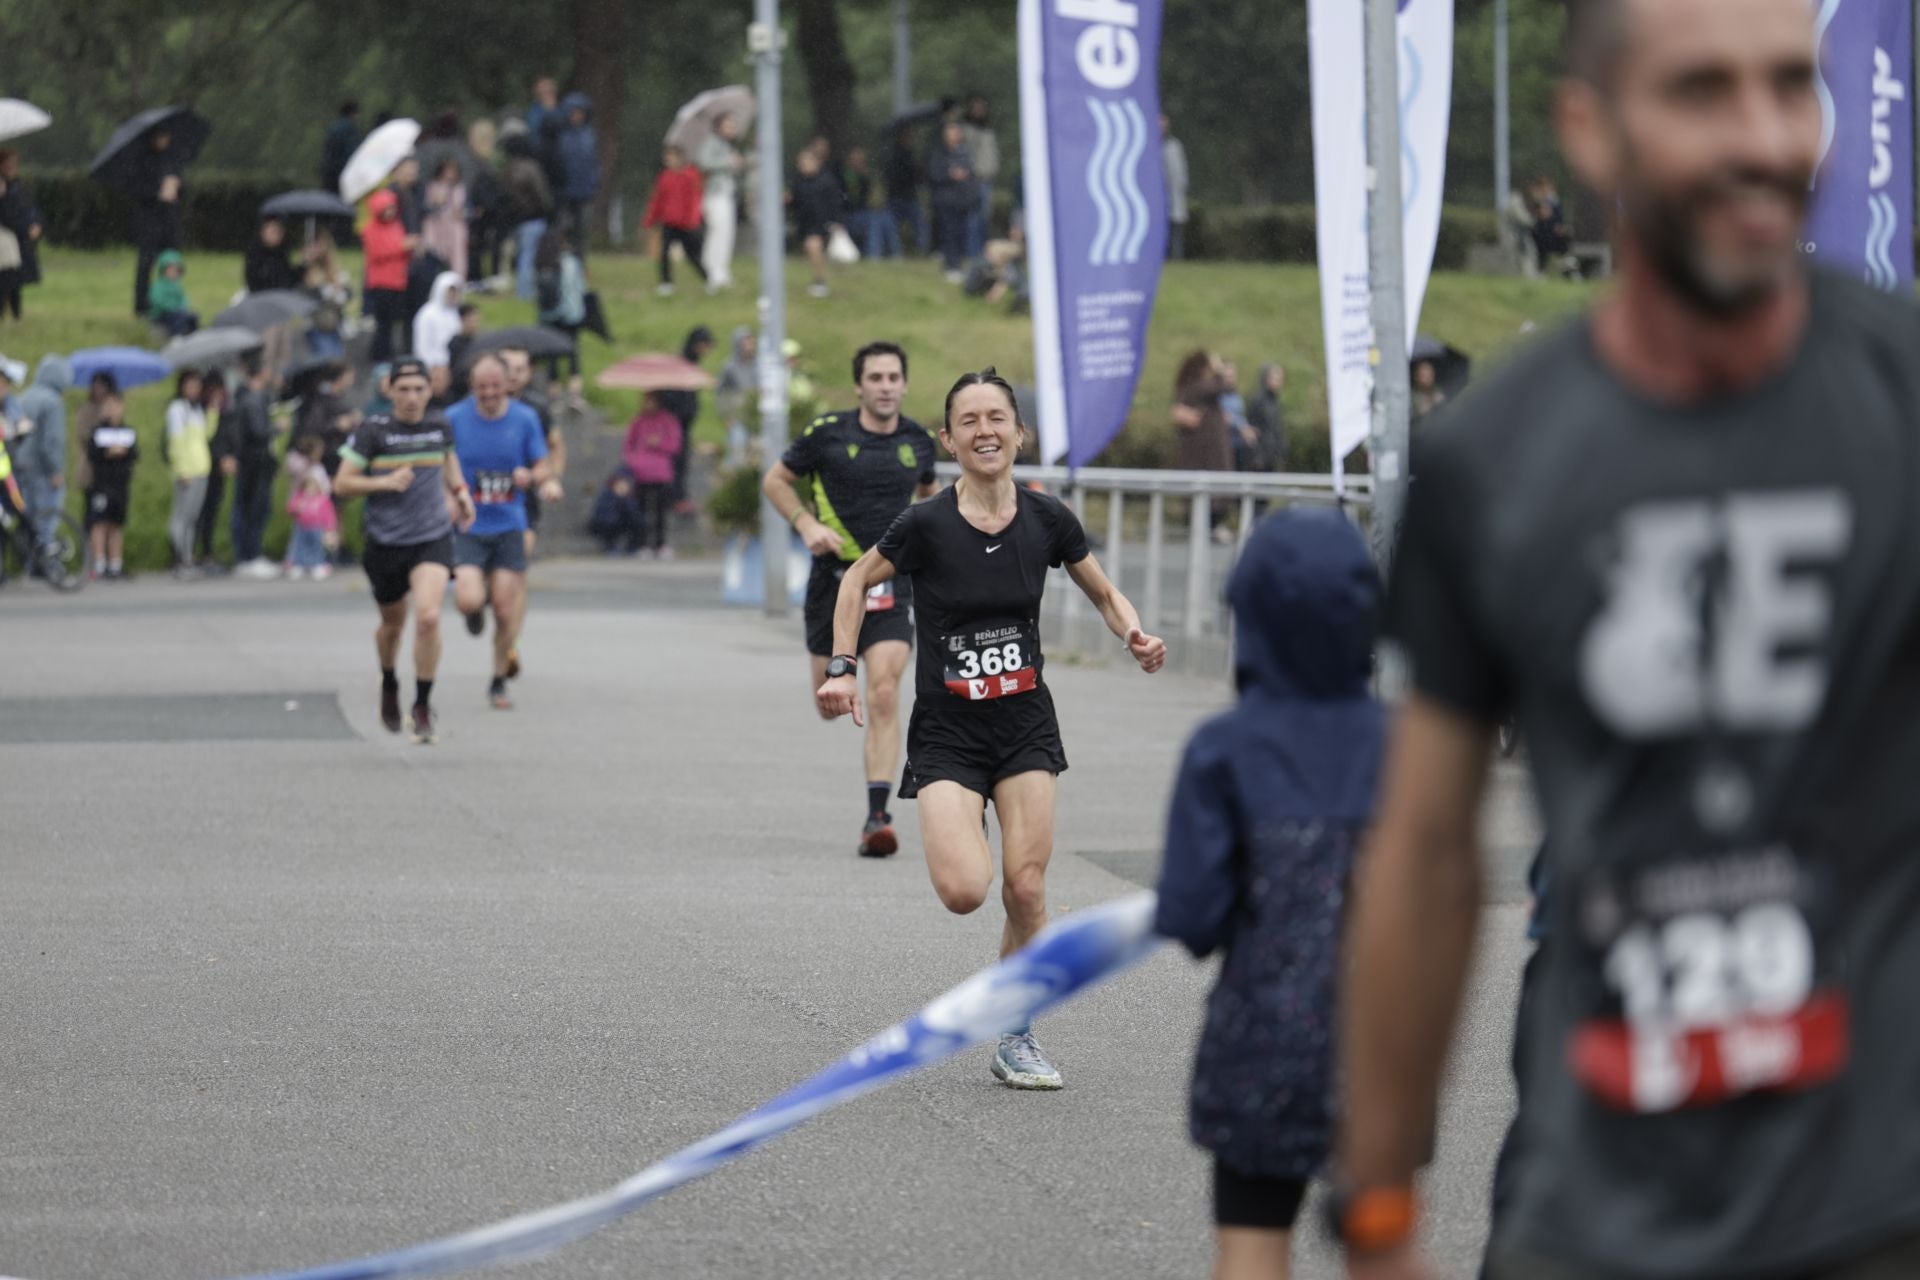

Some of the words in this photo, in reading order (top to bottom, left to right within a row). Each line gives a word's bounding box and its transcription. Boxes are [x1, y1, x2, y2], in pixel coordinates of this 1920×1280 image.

[975, 629, 1000, 641] BEÑAT
[1001, 626, 1018, 635] ELZO
[957, 643, 1022, 678] 368
